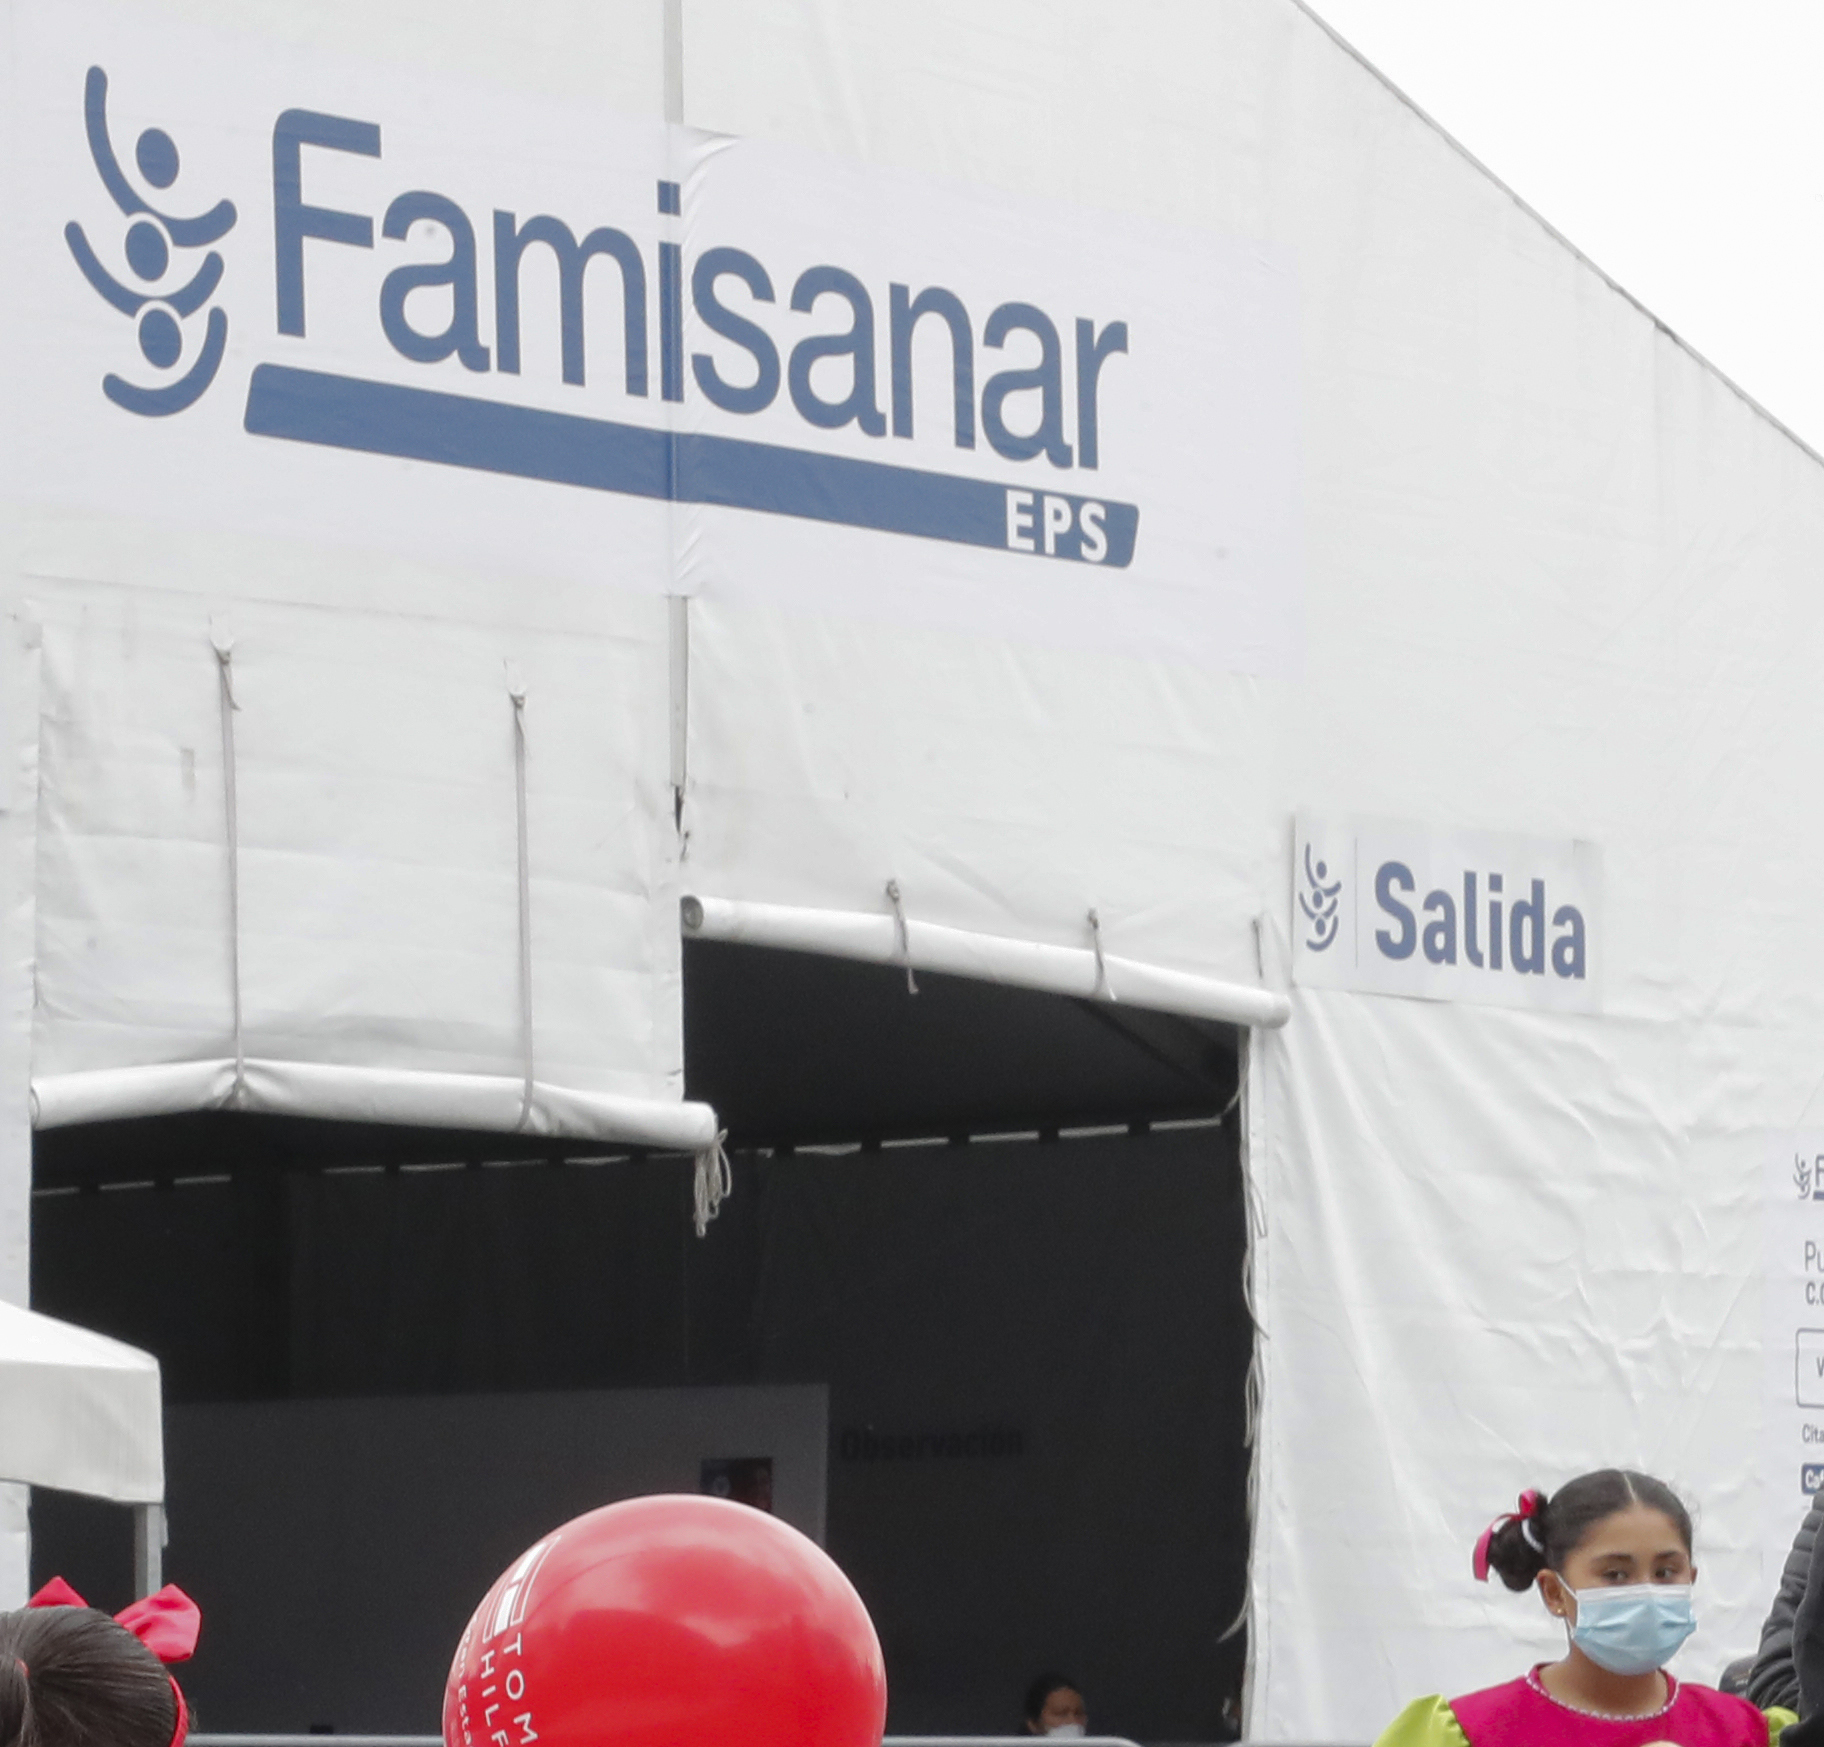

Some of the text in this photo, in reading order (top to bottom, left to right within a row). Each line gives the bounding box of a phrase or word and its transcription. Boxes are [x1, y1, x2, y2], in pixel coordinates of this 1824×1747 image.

[272, 106, 1129, 471] Famisanar
[1005, 489, 1109, 563] EPS
[1374, 860, 1587, 981] Salida
